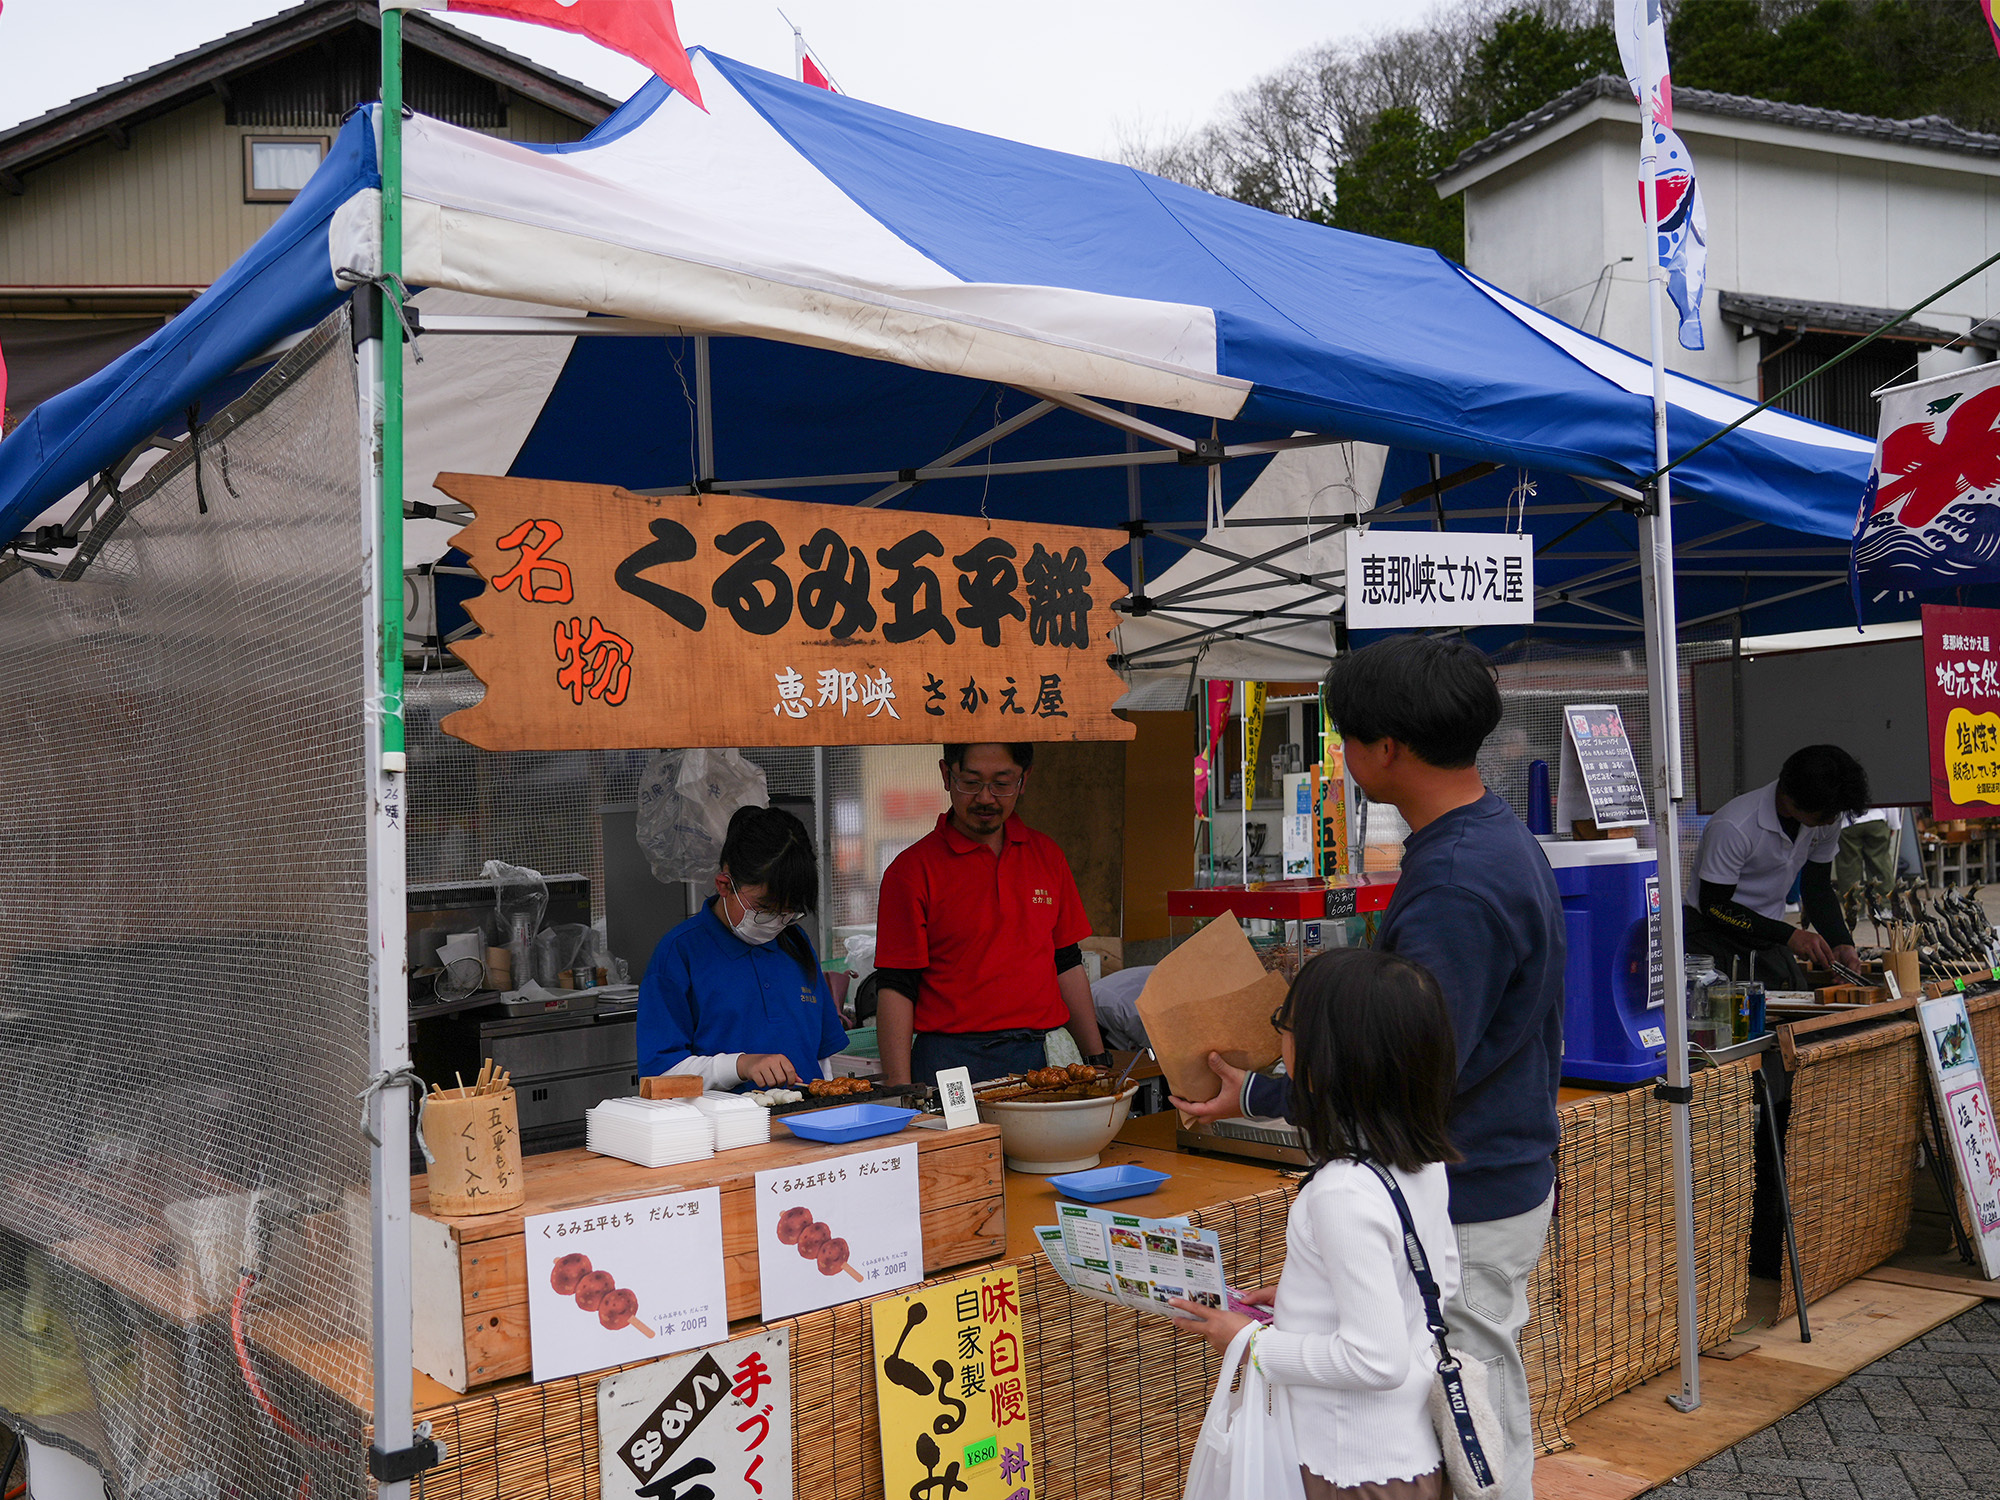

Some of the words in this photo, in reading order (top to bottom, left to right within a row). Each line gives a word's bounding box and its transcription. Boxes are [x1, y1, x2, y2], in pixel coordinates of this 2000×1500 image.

[615, 517, 1094, 650] くるみ五平餅
[1361, 554, 1524, 604] 恵那峡さかえ屋
[495, 518, 634, 706] 名物
[1942, 634, 1990, 652] 恵那峡さかえ屋
[773, 666, 901, 720] 恵那峡
[922, 673, 1068, 719] さかえ屋
[1935, 659, 2000, 699] 地元天然
[1956, 722, 1998, 756] 塩焼き
[1953, 761, 2000, 781] 販売していま
[1327, 890, 1356, 904] からあげ
[1331, 903, 1354, 916] 600円
[1957, 1103, 1982, 1174] 塩焼き
[461, 1121, 489, 1198] くし入れ
[770, 1167, 848, 1195] くるみ五平もち
[858, 1156, 902, 1177] だんご型
[542, 1212, 635, 1239] くるみ五平もち
[649, 1200, 701, 1222] だんご型
[861, 1257, 890, 1267] くるみ五平もち
[866, 1268, 881, 1280] 1本
[884, 1261, 907, 1276] 200円
[653, 1310, 688, 1321] くるみ五平もち
[689, 1304, 709, 1315] だんご型
[659, 1323, 676, 1336] 1本
[681, 1315, 708, 1332] 200円
[956, 1289, 986, 1398] 自家製
[981, 1278, 1026, 1428] 味自慢
[884, 1302, 968, 1500] くるみ
[631, 1372, 720, 1472] くるみ
[731, 1351, 774, 1500] 手づく
[967, 1446, 995, 1466] ¥880
